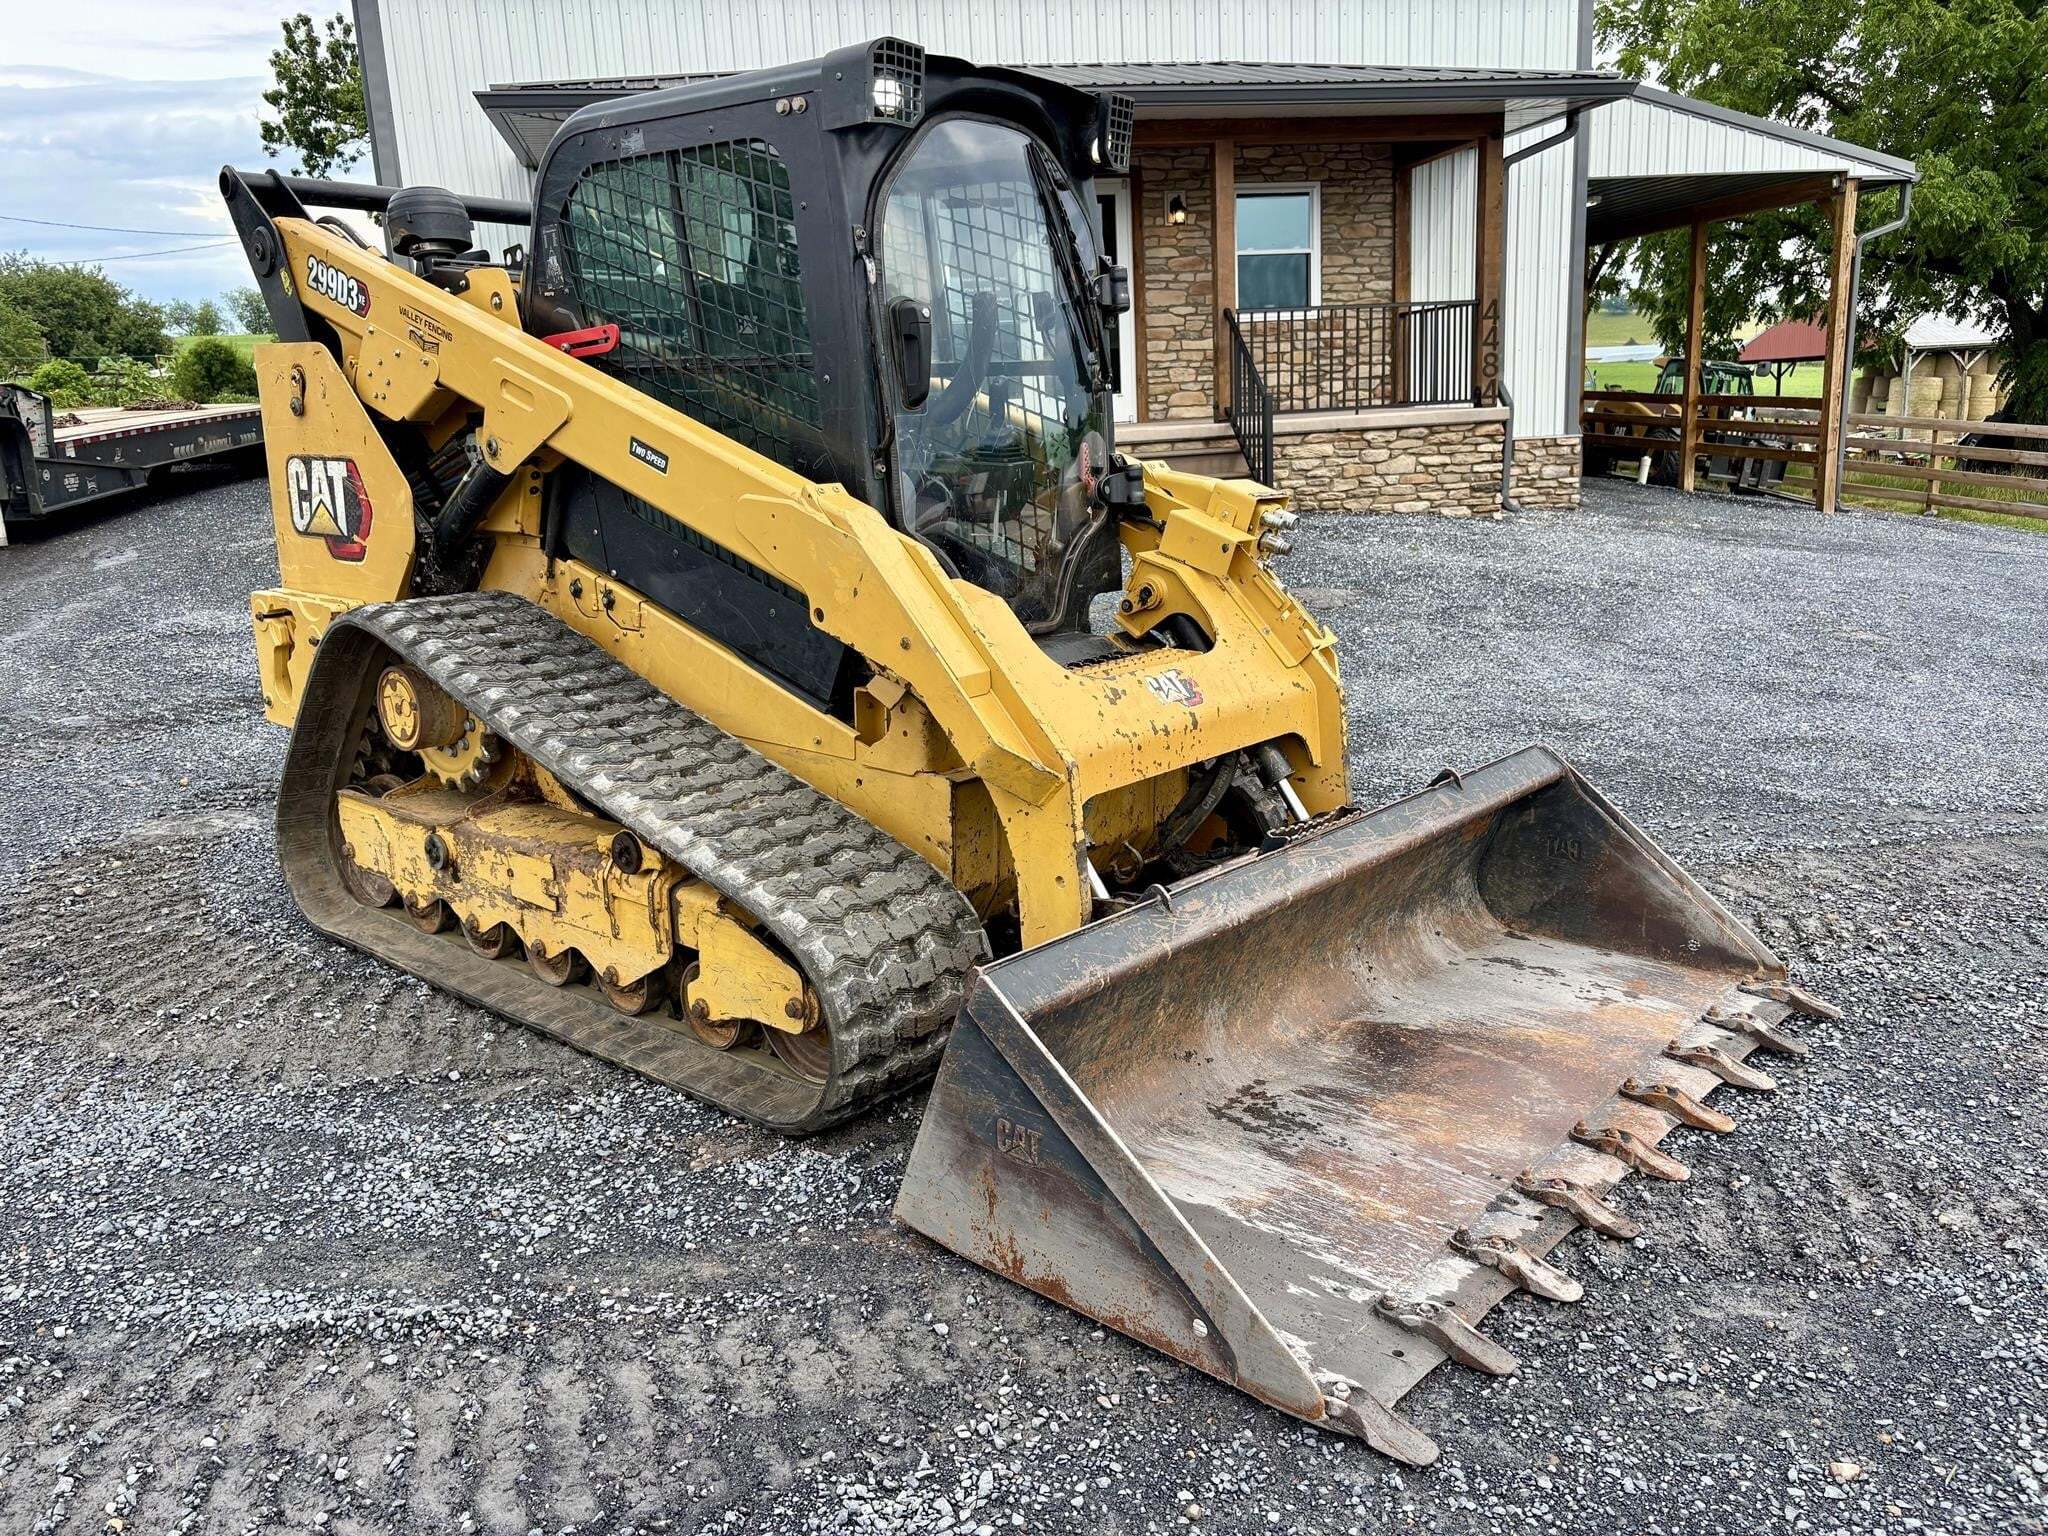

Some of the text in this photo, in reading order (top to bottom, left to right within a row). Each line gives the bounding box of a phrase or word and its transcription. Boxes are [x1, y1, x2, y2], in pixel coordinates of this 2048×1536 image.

[307, 255, 358, 311] 299D3
[399, 304, 453, 342] VALLEY FENCING
[1481, 299, 1499, 407] 4484
[287, 457, 348, 536] CAT
[1143, 669, 1191, 703] CAT
[996, 1117, 1042, 1167] CAT
